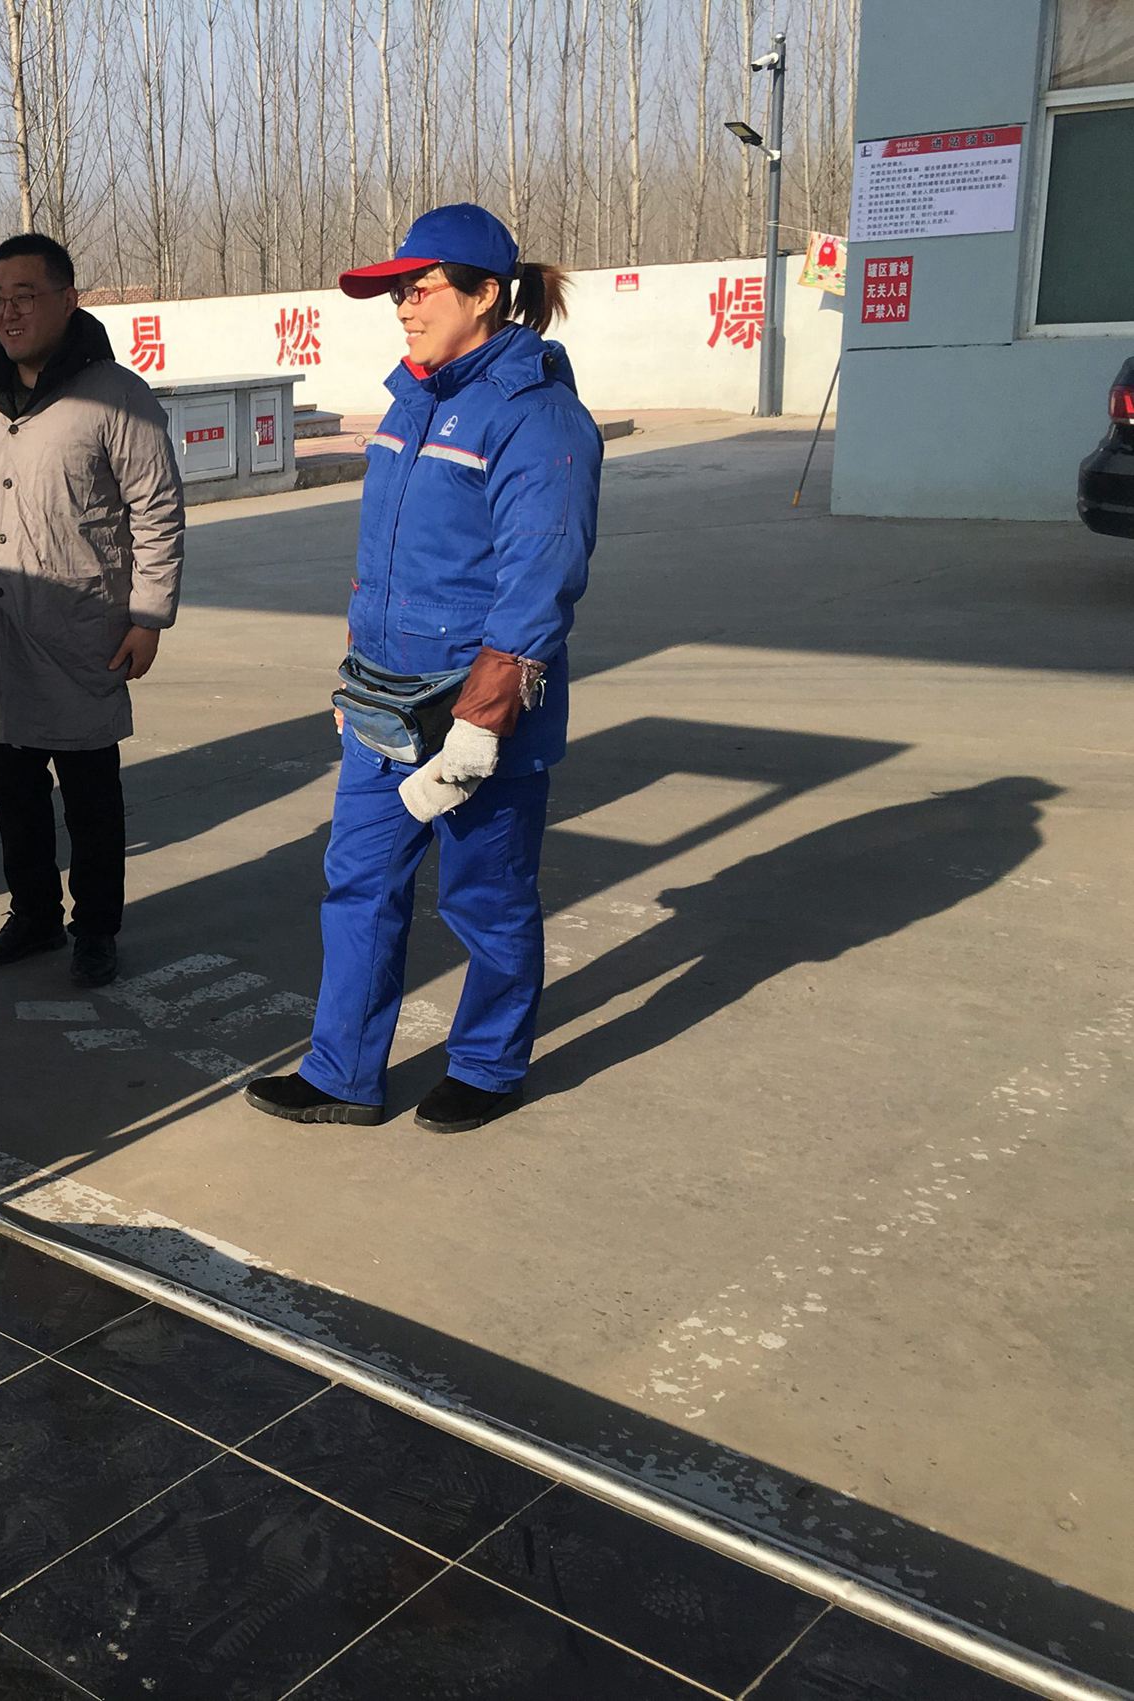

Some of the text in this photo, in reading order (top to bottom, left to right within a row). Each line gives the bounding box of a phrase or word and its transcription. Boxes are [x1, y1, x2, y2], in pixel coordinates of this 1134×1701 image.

[866, 282, 908, 299] 无关人员
[706, 276, 765, 350] 爆
[864, 303, 906, 319] 严禁入内
